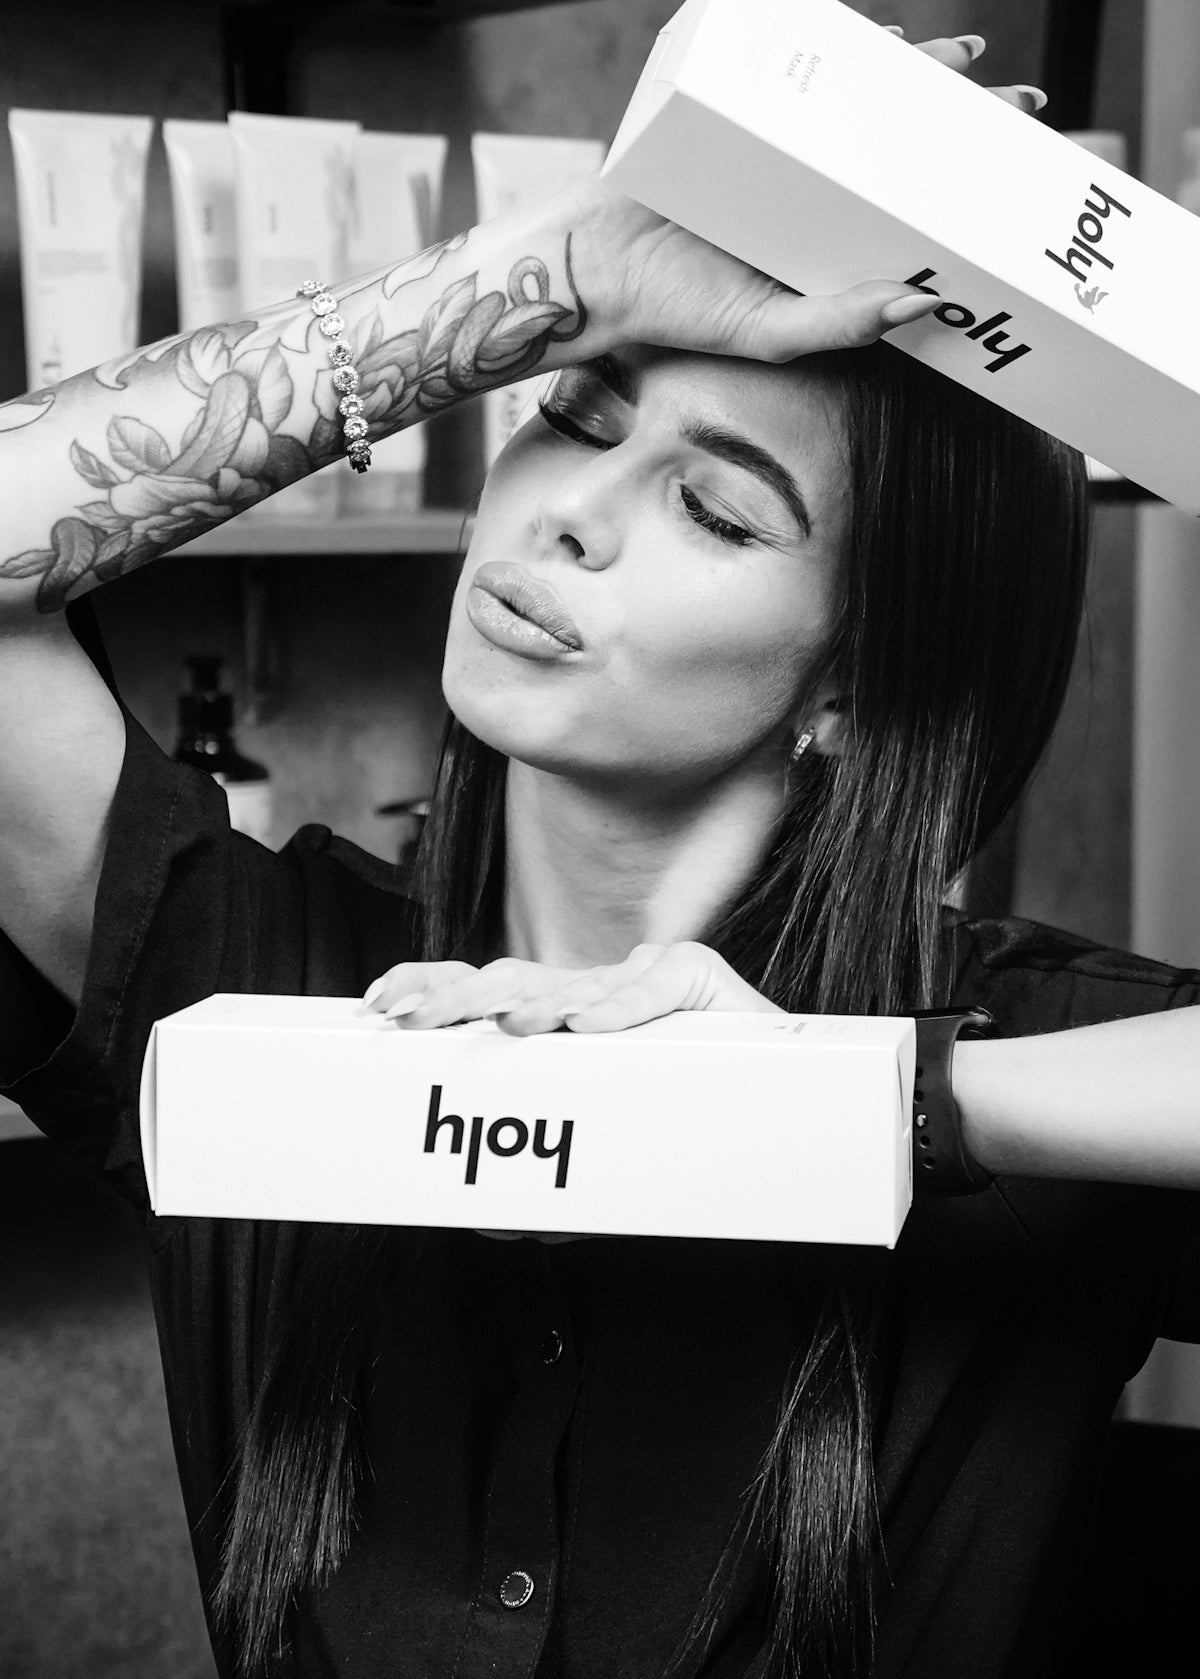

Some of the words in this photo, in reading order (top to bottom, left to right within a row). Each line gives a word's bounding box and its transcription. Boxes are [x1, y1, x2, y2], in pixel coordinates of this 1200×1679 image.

[785, 50, 804, 79] Mask
[797, 53, 821, 94] Refresh
[1044, 183, 1132, 284] holy
[422, 1084, 575, 1190] holy
